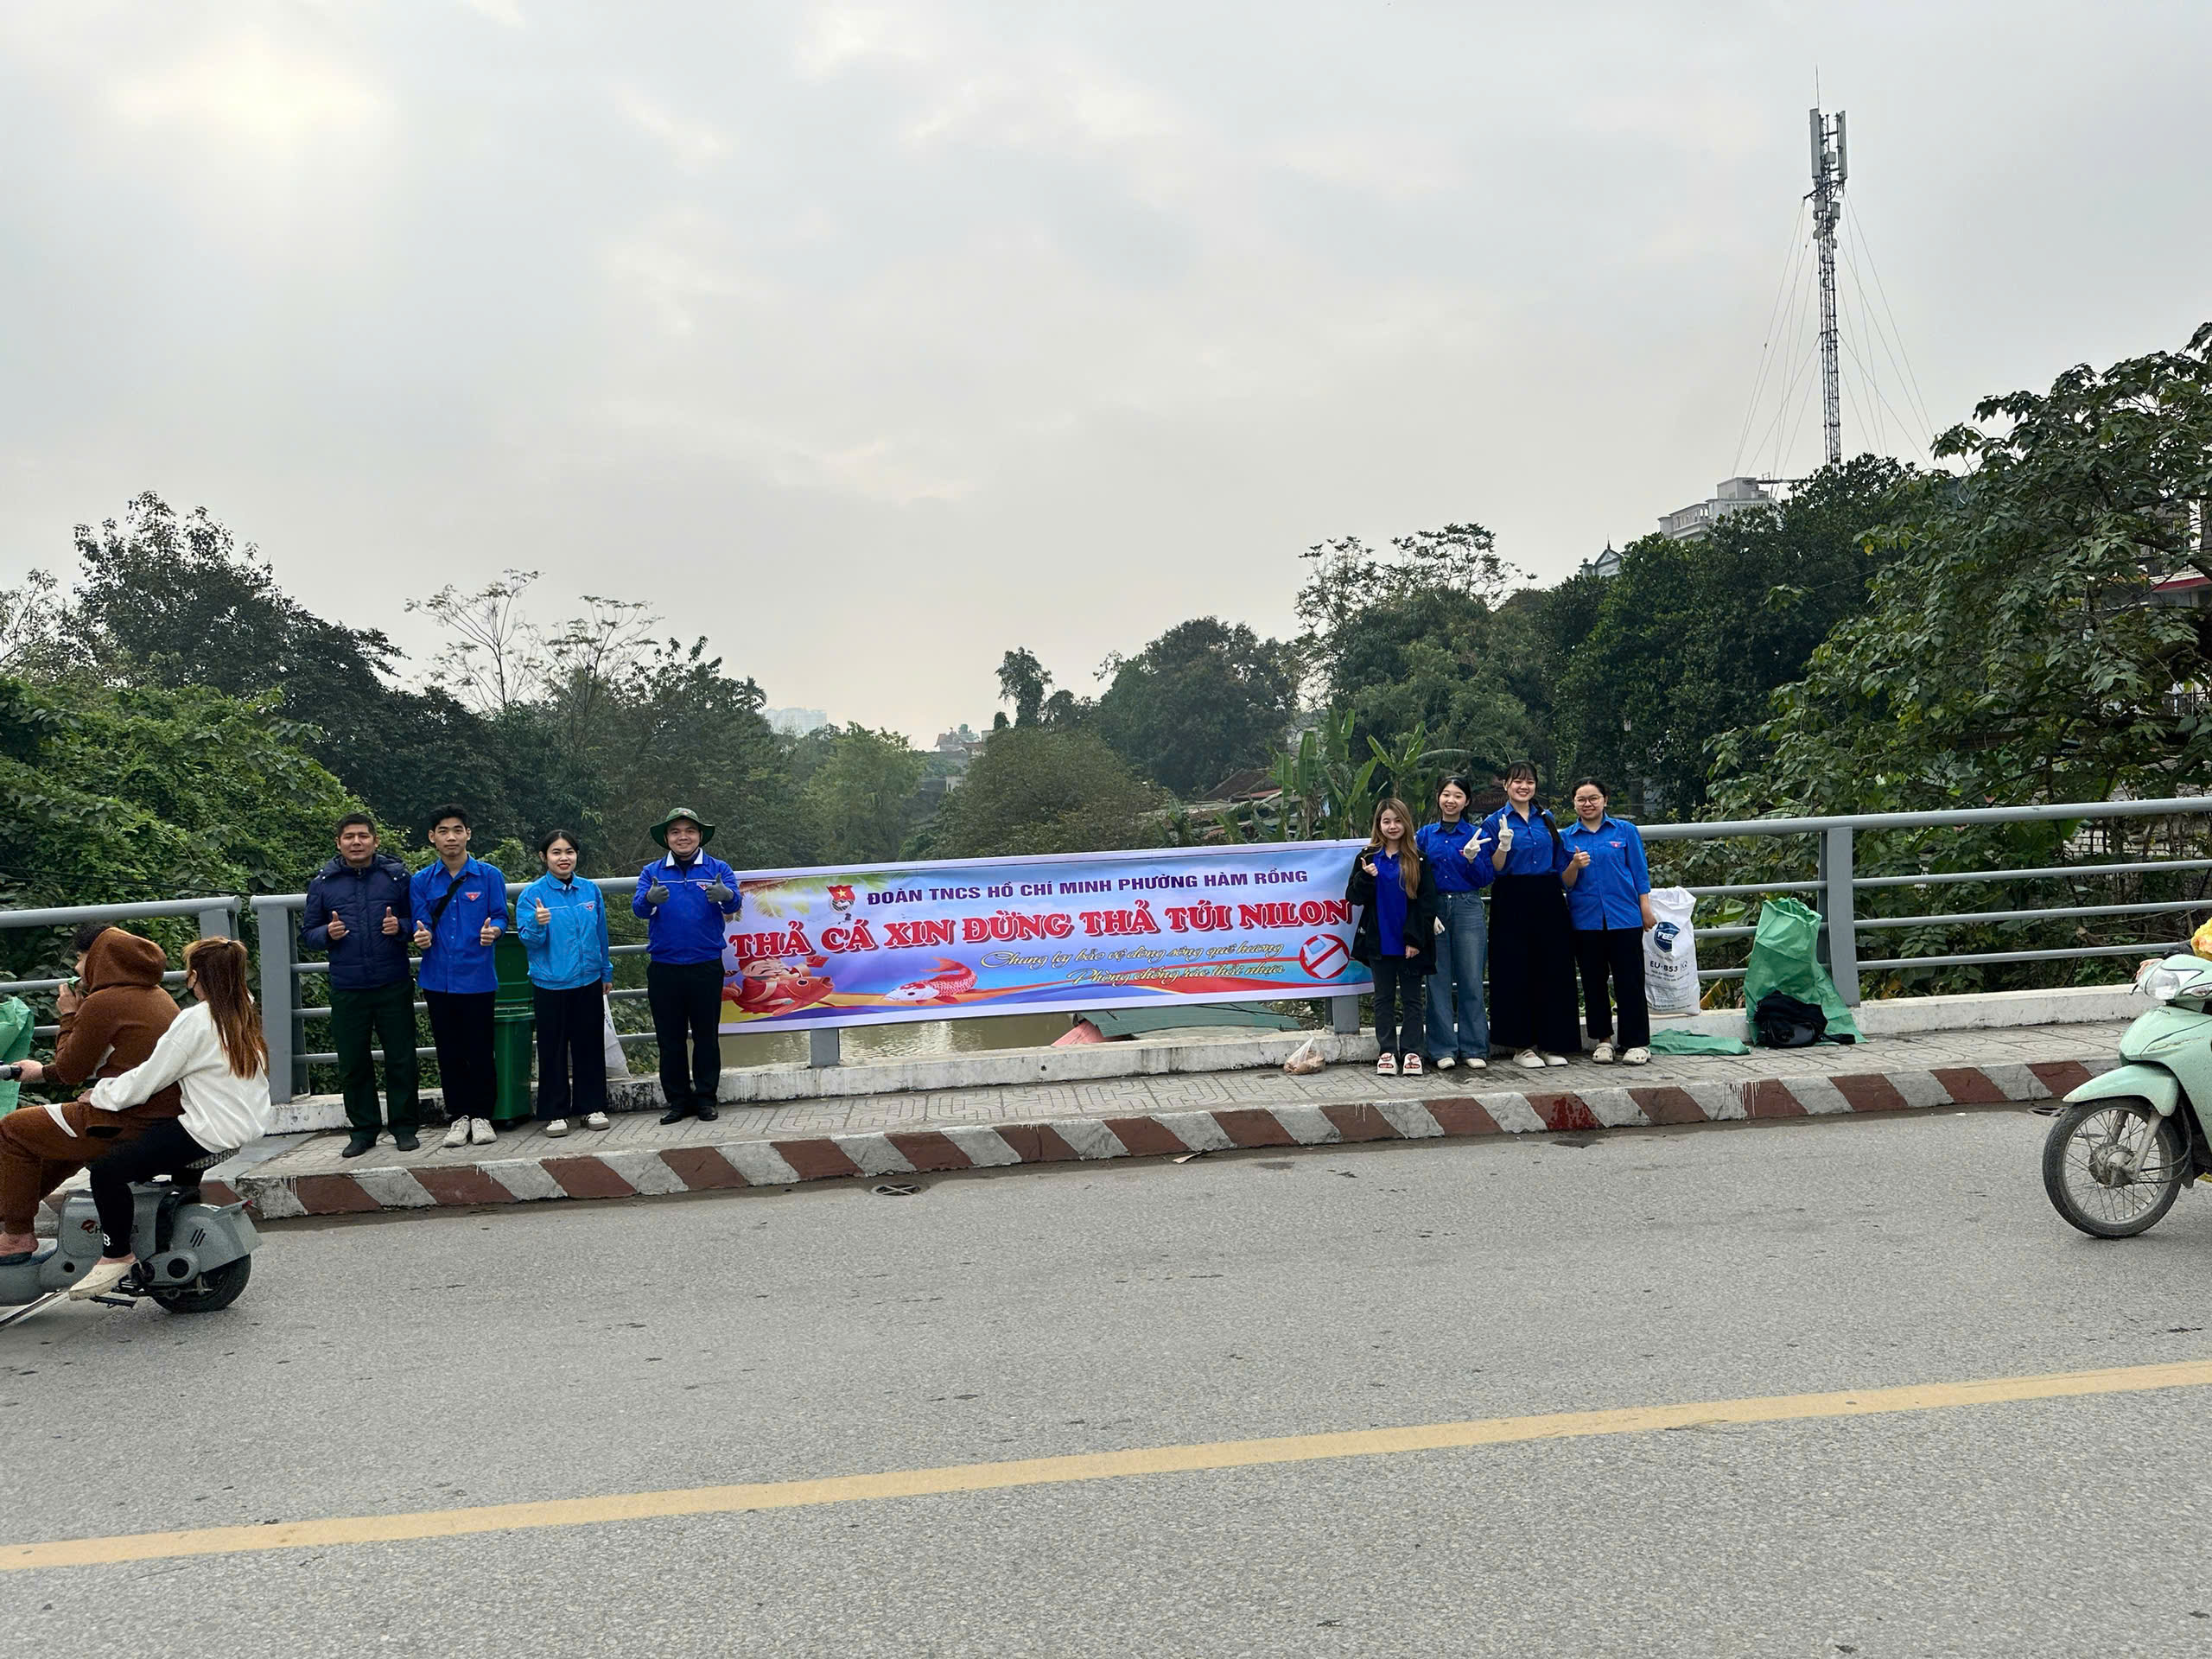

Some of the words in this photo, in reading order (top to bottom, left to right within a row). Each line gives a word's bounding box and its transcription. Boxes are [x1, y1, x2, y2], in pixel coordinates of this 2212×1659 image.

[868, 887, 923, 905] ĐOÀN
[929, 887, 981, 900] TNCS
[988, 881, 1014, 898] HỒ
[1020, 880, 1052, 896] CHÍ
[1060, 880, 1112, 894] MINH
[1118, 874, 1198, 891] PHƯỜNG
[1204, 871, 1248, 887] HÀM
[1255, 868, 1308, 885] RỒNG
[728, 920, 816, 958] THẢ
[821, 918, 878, 953] CÁ
[883, 919, 956, 949] XIN
[962, 910, 1075, 944] ĐỪNG
[1078, 899, 1160, 937] THẢ
[1165, 899, 1233, 933] TÚI
[1238, 899, 1354, 930] NILON
[981, 950, 1048, 970] Chung
[1051, 951, 1072, 969] tay
[1066, 967, 1131, 988] Phòng
